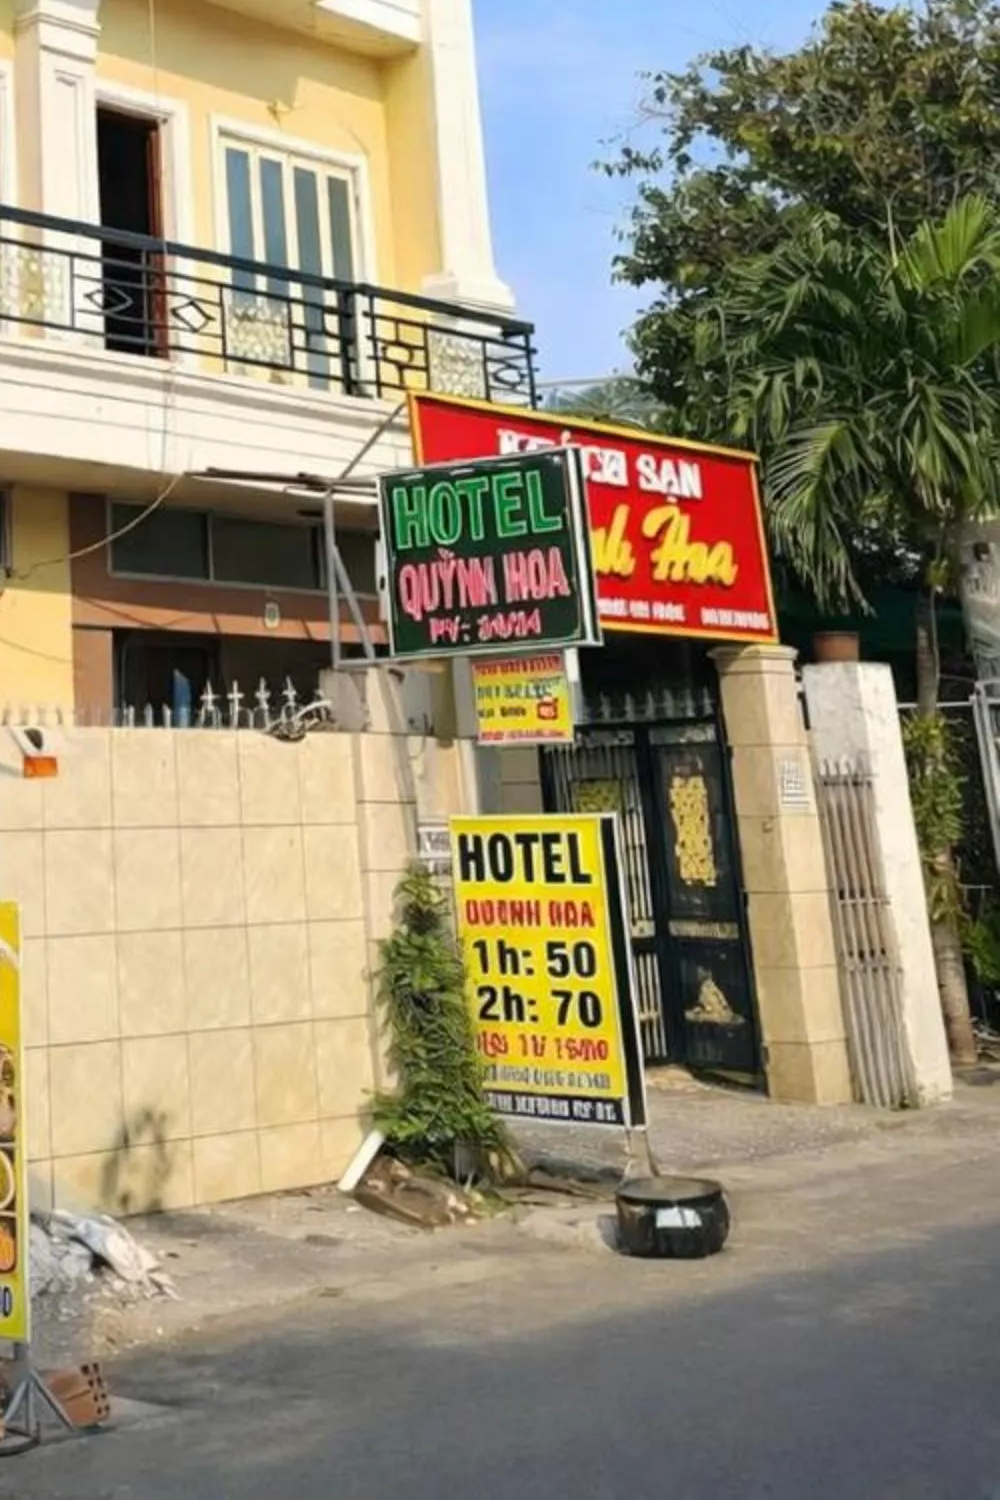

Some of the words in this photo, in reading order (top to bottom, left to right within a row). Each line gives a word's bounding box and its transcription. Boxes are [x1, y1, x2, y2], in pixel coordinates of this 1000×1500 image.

[393, 469, 563, 550] HOTEL
[458, 832, 592, 884] HOTEL
[546, 941, 597, 979] 50
[477, 985, 539, 1023] 2h:
[551, 990, 603, 1028] 70
